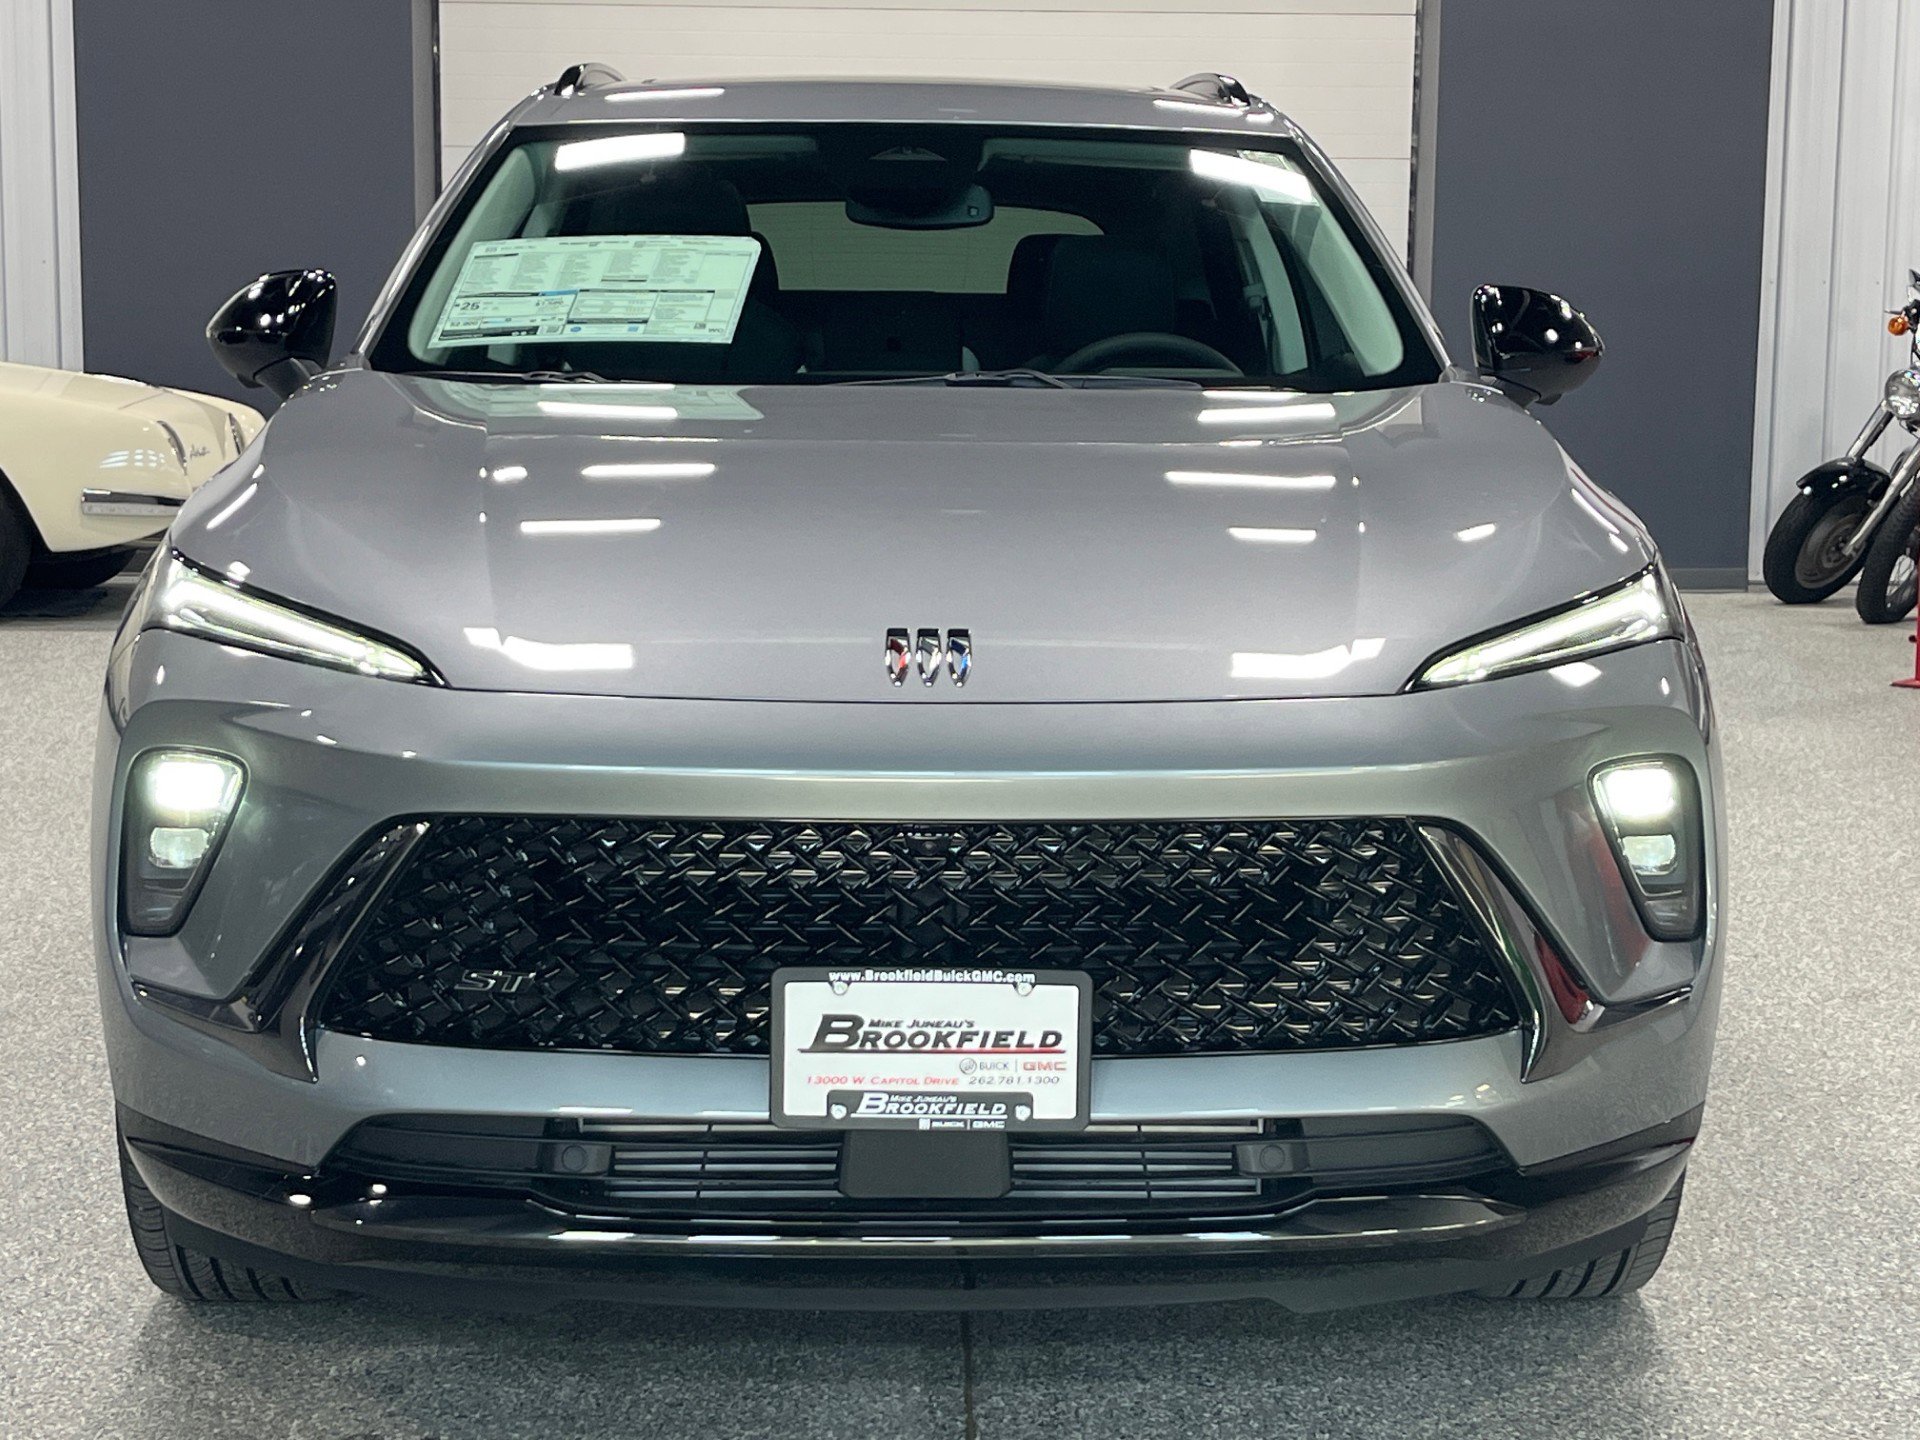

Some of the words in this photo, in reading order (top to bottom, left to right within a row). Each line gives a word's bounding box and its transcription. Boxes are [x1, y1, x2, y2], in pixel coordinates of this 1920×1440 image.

[454, 970, 537, 993] ST
[828, 969, 1036, 983] www.BrookfieldBuickGMC.com
[809, 1013, 1063, 1050] BROOKFIELD
[979, 1061, 1010, 1071] BUICK
[1023, 1061, 1067, 1071] GMC
[807, 1076, 849, 1085] 13000
[969, 1076, 1060, 1085] 262.781.1300
[857, 1092, 1006, 1114] BROOKFIELD
